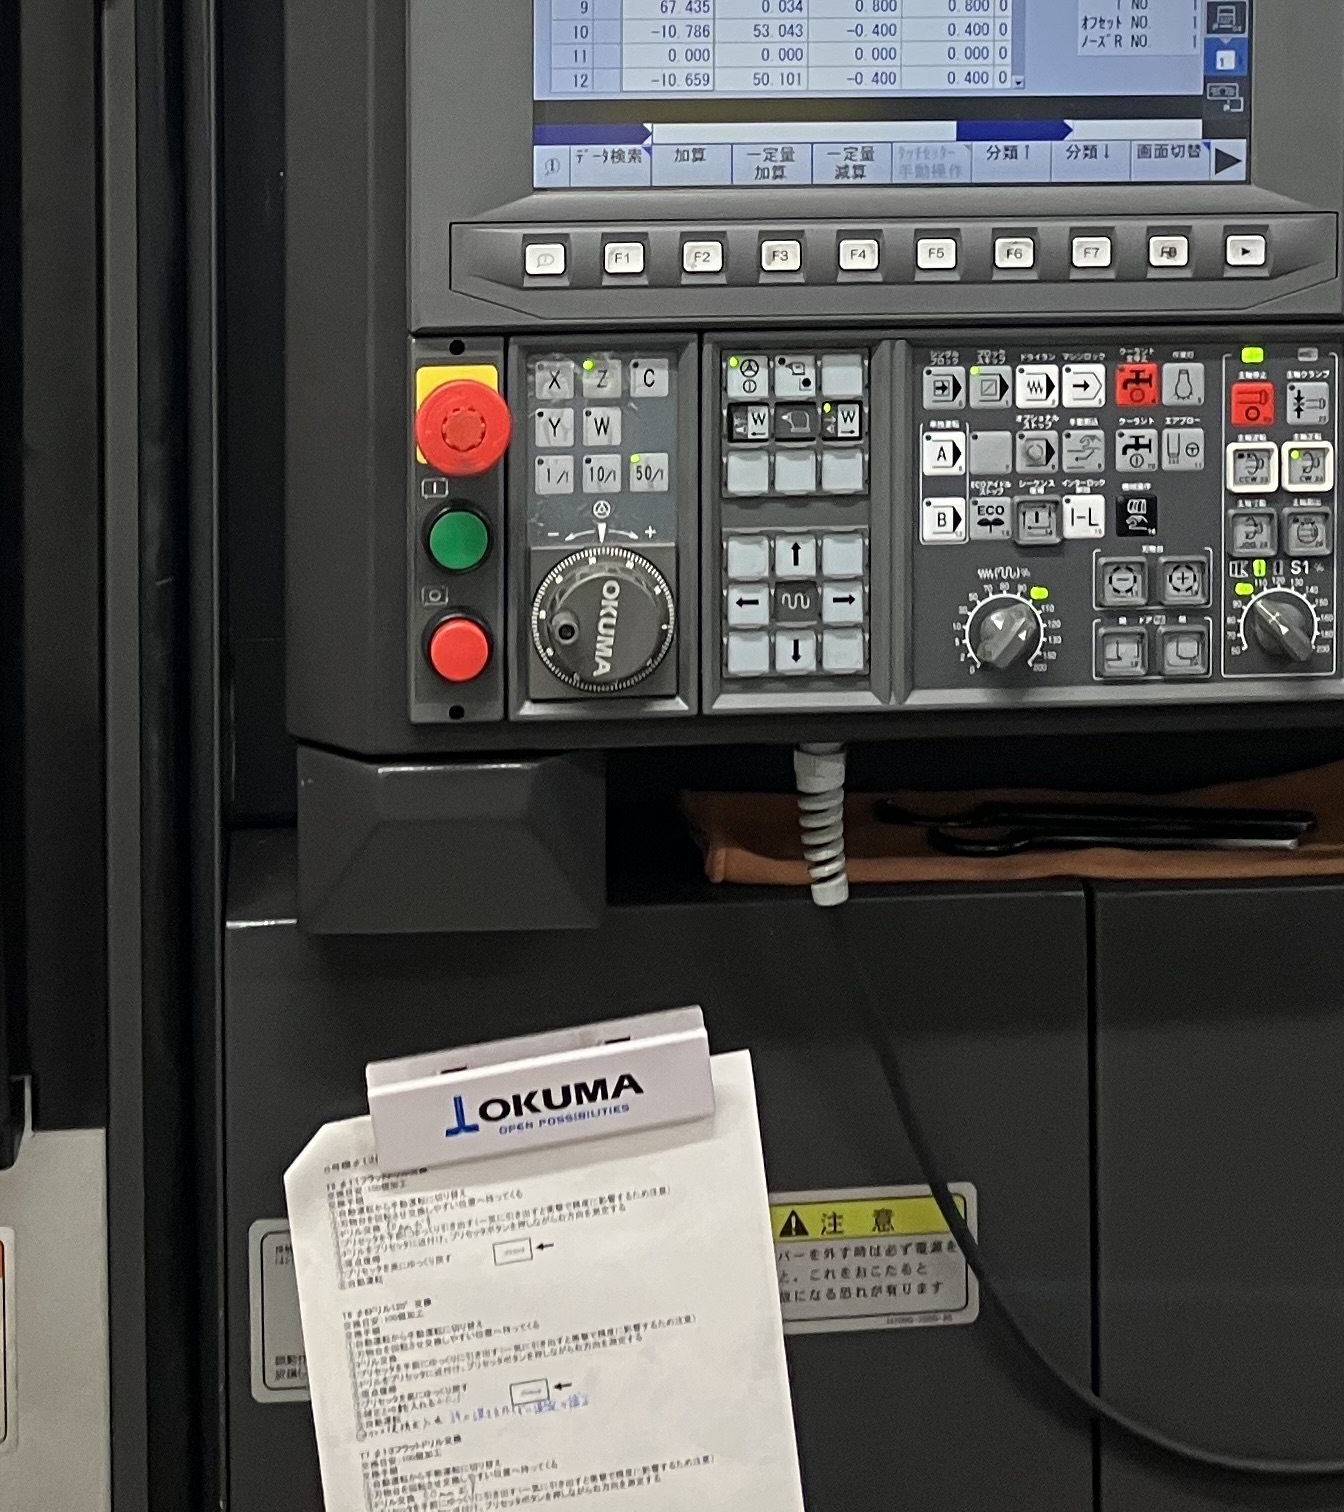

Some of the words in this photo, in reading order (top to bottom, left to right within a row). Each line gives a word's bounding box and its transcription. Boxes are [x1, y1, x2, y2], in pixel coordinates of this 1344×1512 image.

[660, 0, 711, 14] 67.435
[762, 0, 804, 14] 0.034
[651, 24, 711, 39] -10.786
[754, 24, 803, 39] 53.043
[668, 48, 710, 63] 0.000
[762, 48, 803, 63] 0.000
[651, 72, 710, 87] -10.659
[754, 72, 802, 87] 50.101
[675, 148, 706, 162] 加算
[747, 147, 795, 164] 一定量
[827, 147, 875, 162] 一定量
[1138, 144, 1202, 160] 画面切替
[755, 165, 786, 180] 加算
[835, 165, 867, 180] 減算
[614, 252, 631, 264] F1
[694, 251, 710, 264] F2
[772, 249, 789, 262] F3
[850, 248, 866, 261] F4
[928, 247, 945, 260] F5
[1006, 247, 1023, 260] F6
[1083, 246, 1100, 259] F7
[548, 371, 560, 389] X
[597, 370, 608, 388] Z
[644, 369, 655, 387] C
[549, 419, 560, 437] Y
[594, 417, 609, 435] W
[937, 447, 947, 461] A
[589, 466, 616, 482] 10/1
[636, 465, 664, 481] 50/1
[978, 506, 1004, 515] ECO
[937, 513, 946, 527] B
[1291, 561, 1309, 574] S1
[594, 580, 619, 676] OKUMA
[479, 1073, 644, 1122] OKUMA
[499, 1120, 534, 1135] OPEN
[538, 1103, 630, 1129] POSSIBILITIES
